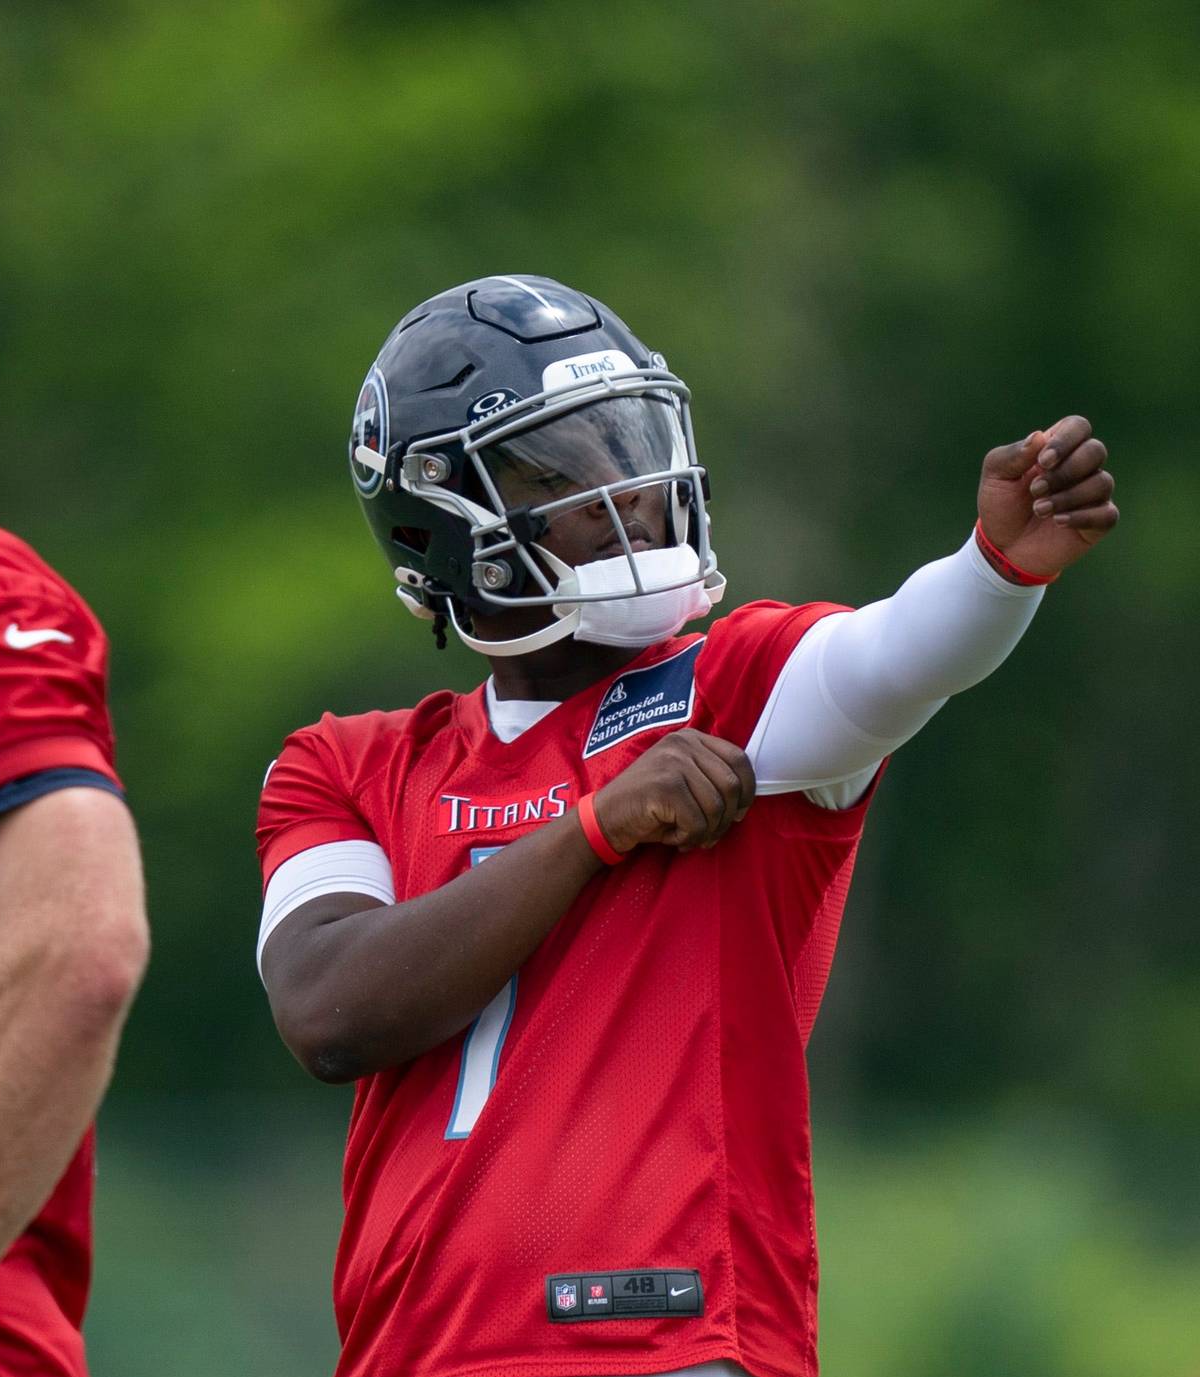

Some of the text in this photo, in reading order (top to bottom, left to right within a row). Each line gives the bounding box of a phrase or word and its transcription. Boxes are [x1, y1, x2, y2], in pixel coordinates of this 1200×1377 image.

[589, 700, 687, 747] Saint Thomas
[595, 692, 665, 731] Ascension
[440, 782, 569, 832] TITANS
[624, 1276, 655, 1294] 48
